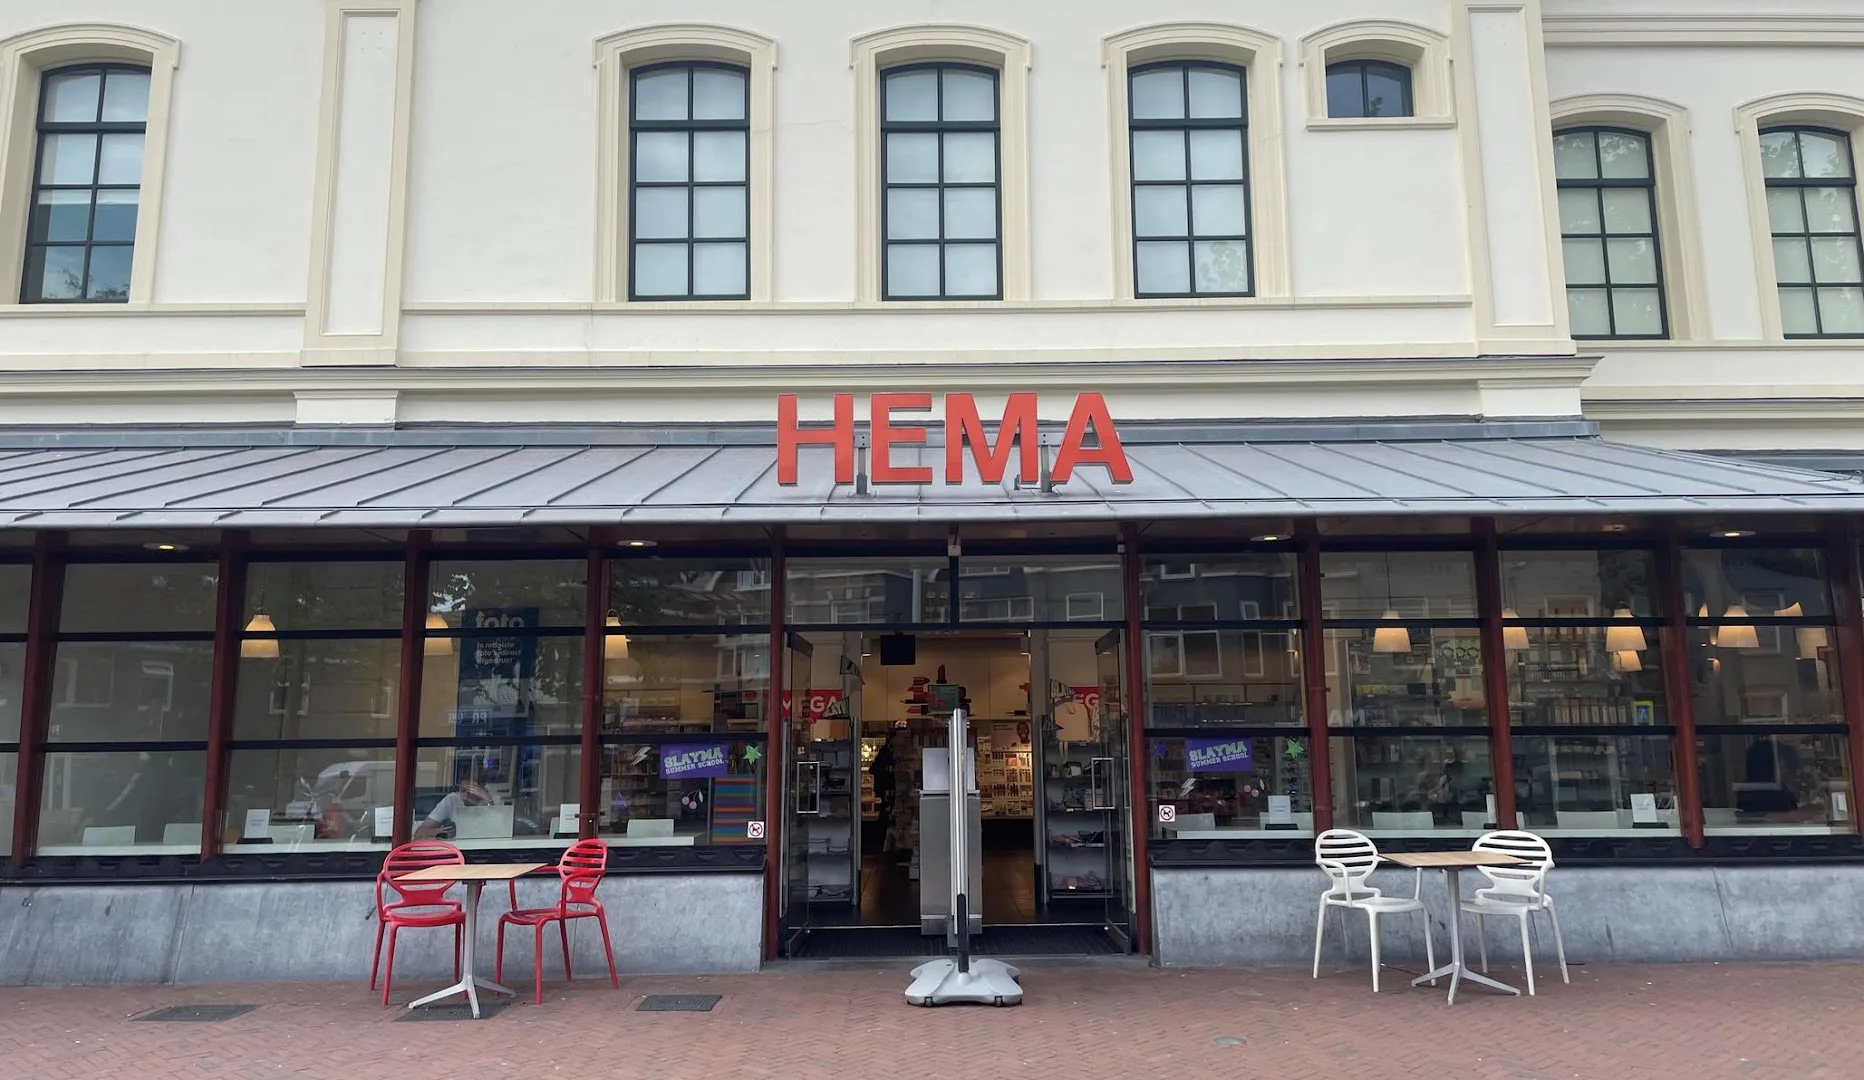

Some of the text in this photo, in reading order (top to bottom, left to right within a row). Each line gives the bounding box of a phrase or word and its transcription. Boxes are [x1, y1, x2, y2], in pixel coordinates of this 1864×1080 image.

[778, 392, 1134, 486] HEMA
[664, 747, 723, 769] SLAYMA
[1189, 741, 1248, 761] SLAYMA
[1190, 751, 1249, 768] SUMMER SCHOOL
[665, 758, 725, 775] SUMMER SCHOOL
